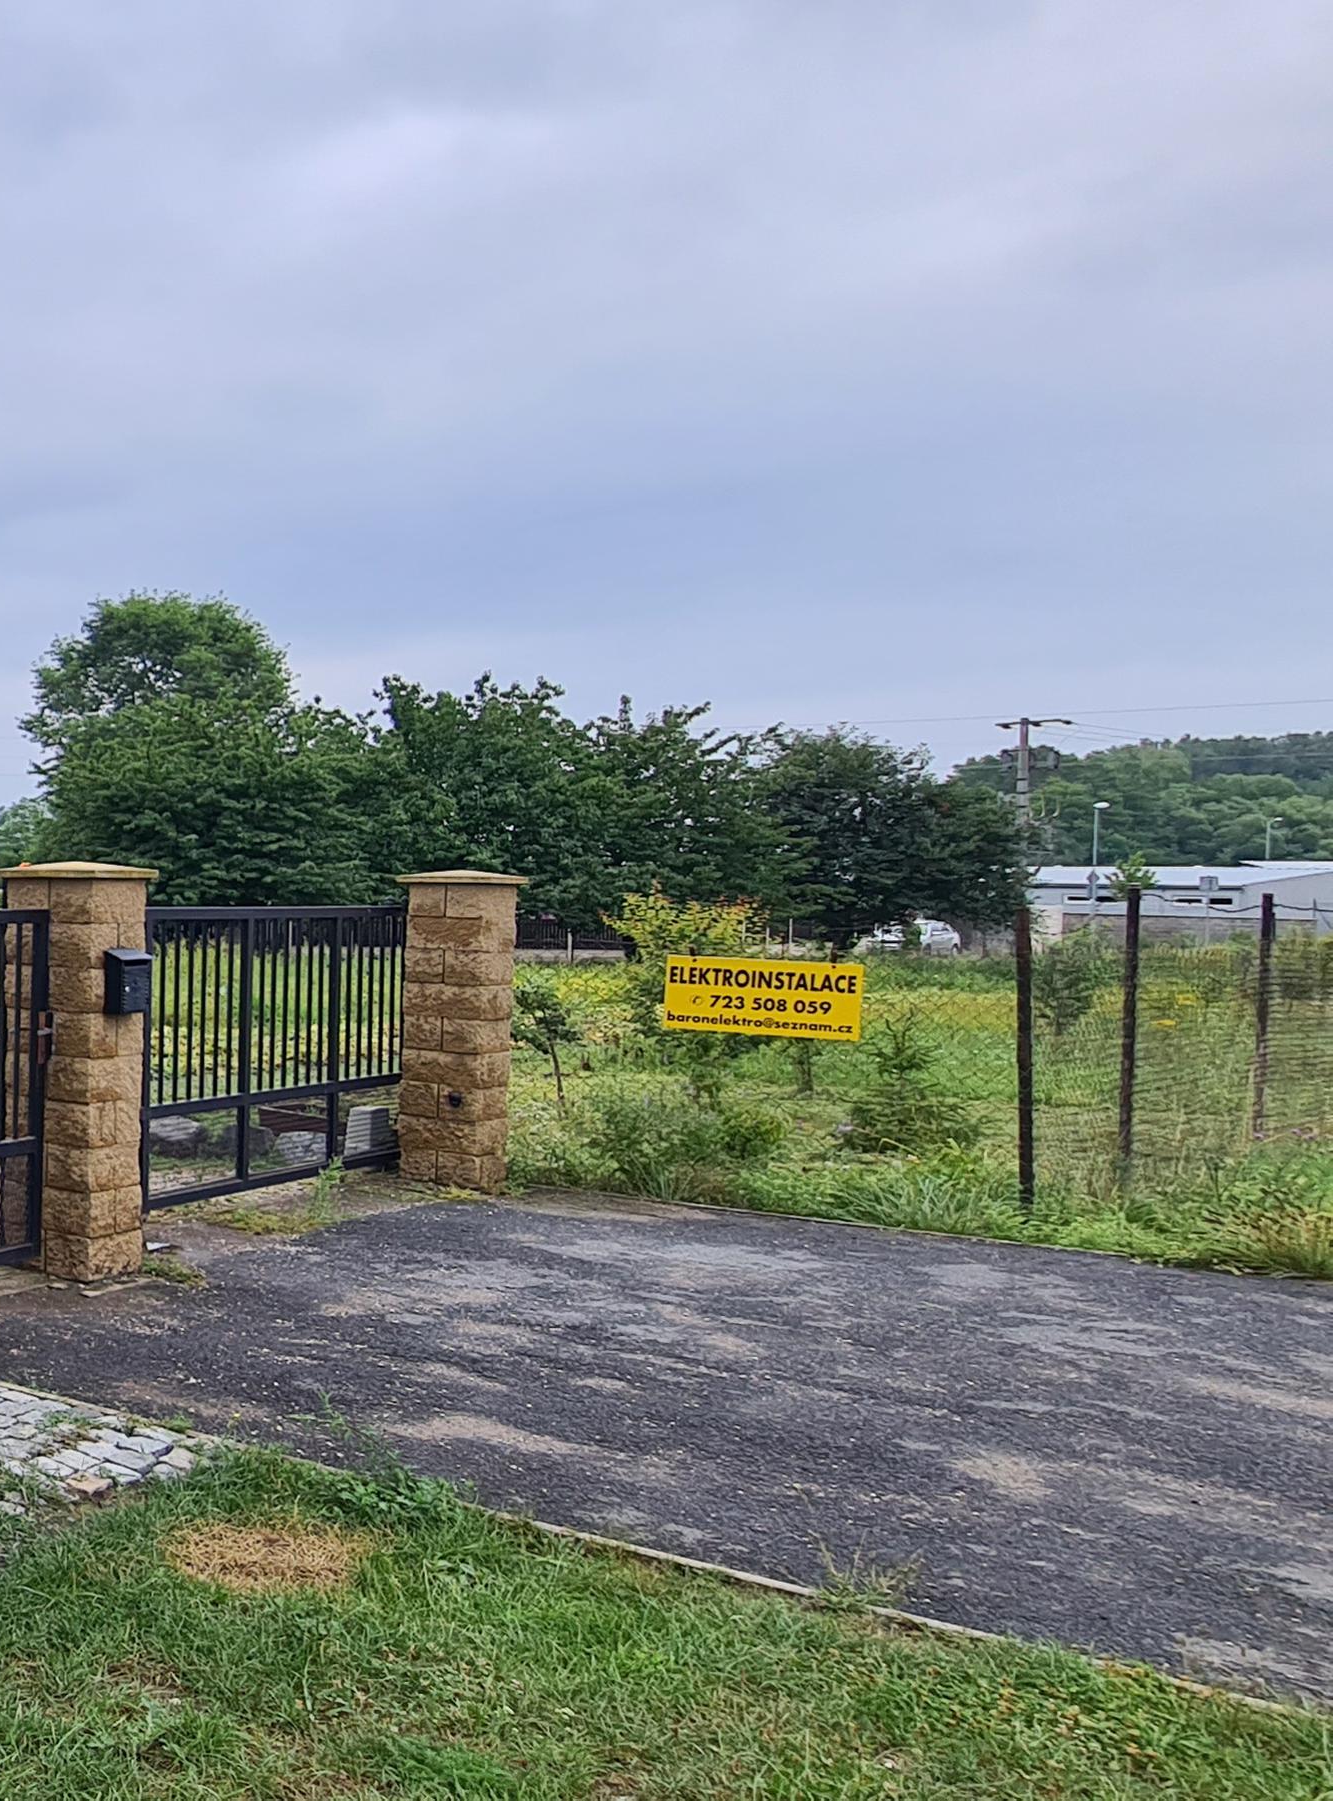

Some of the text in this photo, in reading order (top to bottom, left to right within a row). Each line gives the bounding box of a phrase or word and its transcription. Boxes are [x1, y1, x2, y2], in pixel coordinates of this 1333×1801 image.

[669, 966, 857, 994] ELEKTROINSTALACE
[710, 995, 831, 1014] 723 508 059
[667, 1011, 853, 1033] baronelektro@seznam.cz
